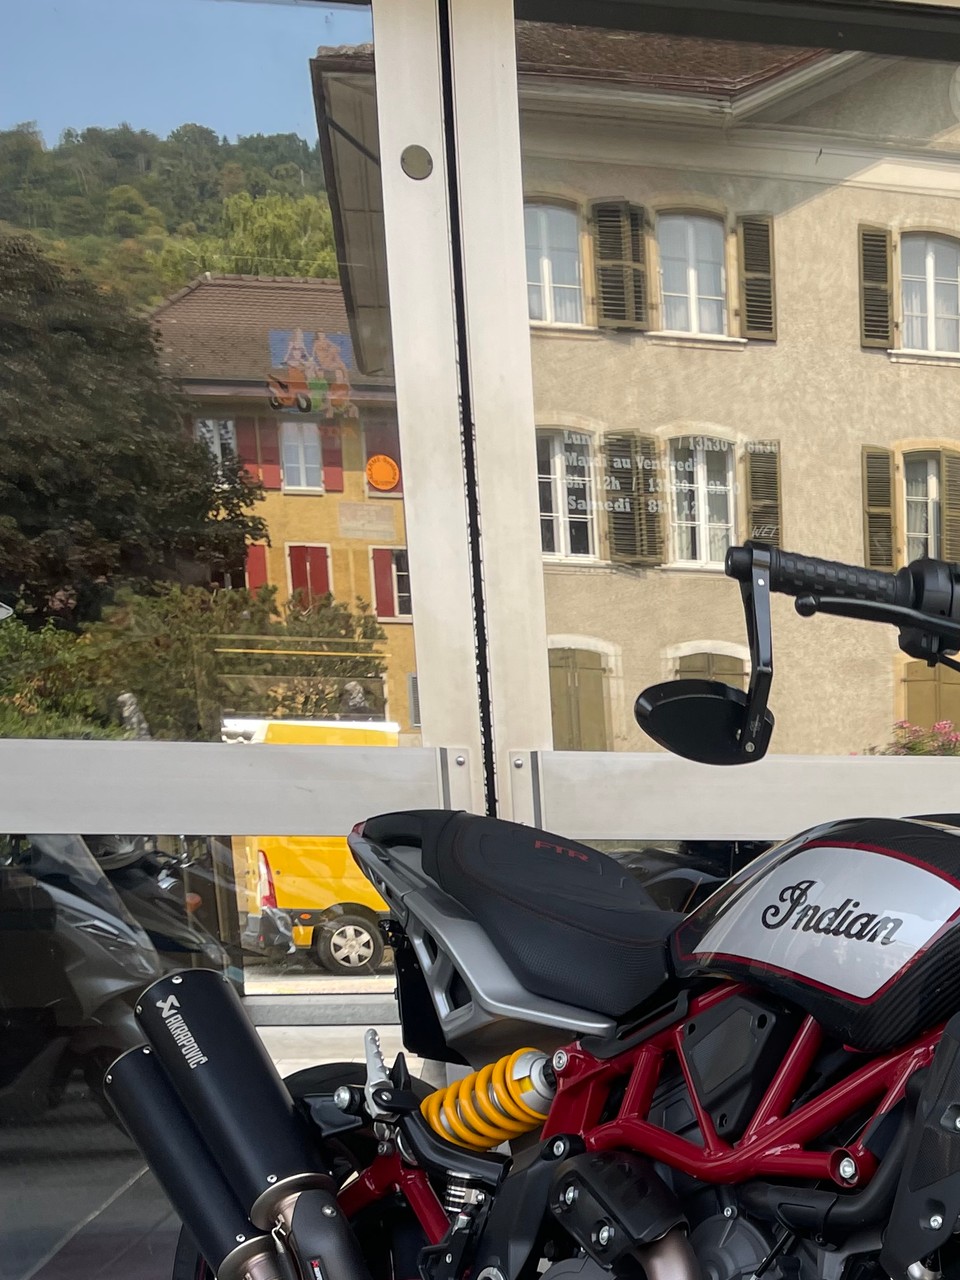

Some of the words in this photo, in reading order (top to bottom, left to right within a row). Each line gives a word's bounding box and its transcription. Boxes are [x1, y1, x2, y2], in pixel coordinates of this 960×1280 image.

[563, 430, 606, 446] Luni
[688, 437, 728, 452] 13h30
[613, 458, 632, 469] au
[568, 496, 631, 512] Samedi
[534, 840, 589, 862] FTR
[761, 880, 904, 946] Indian
